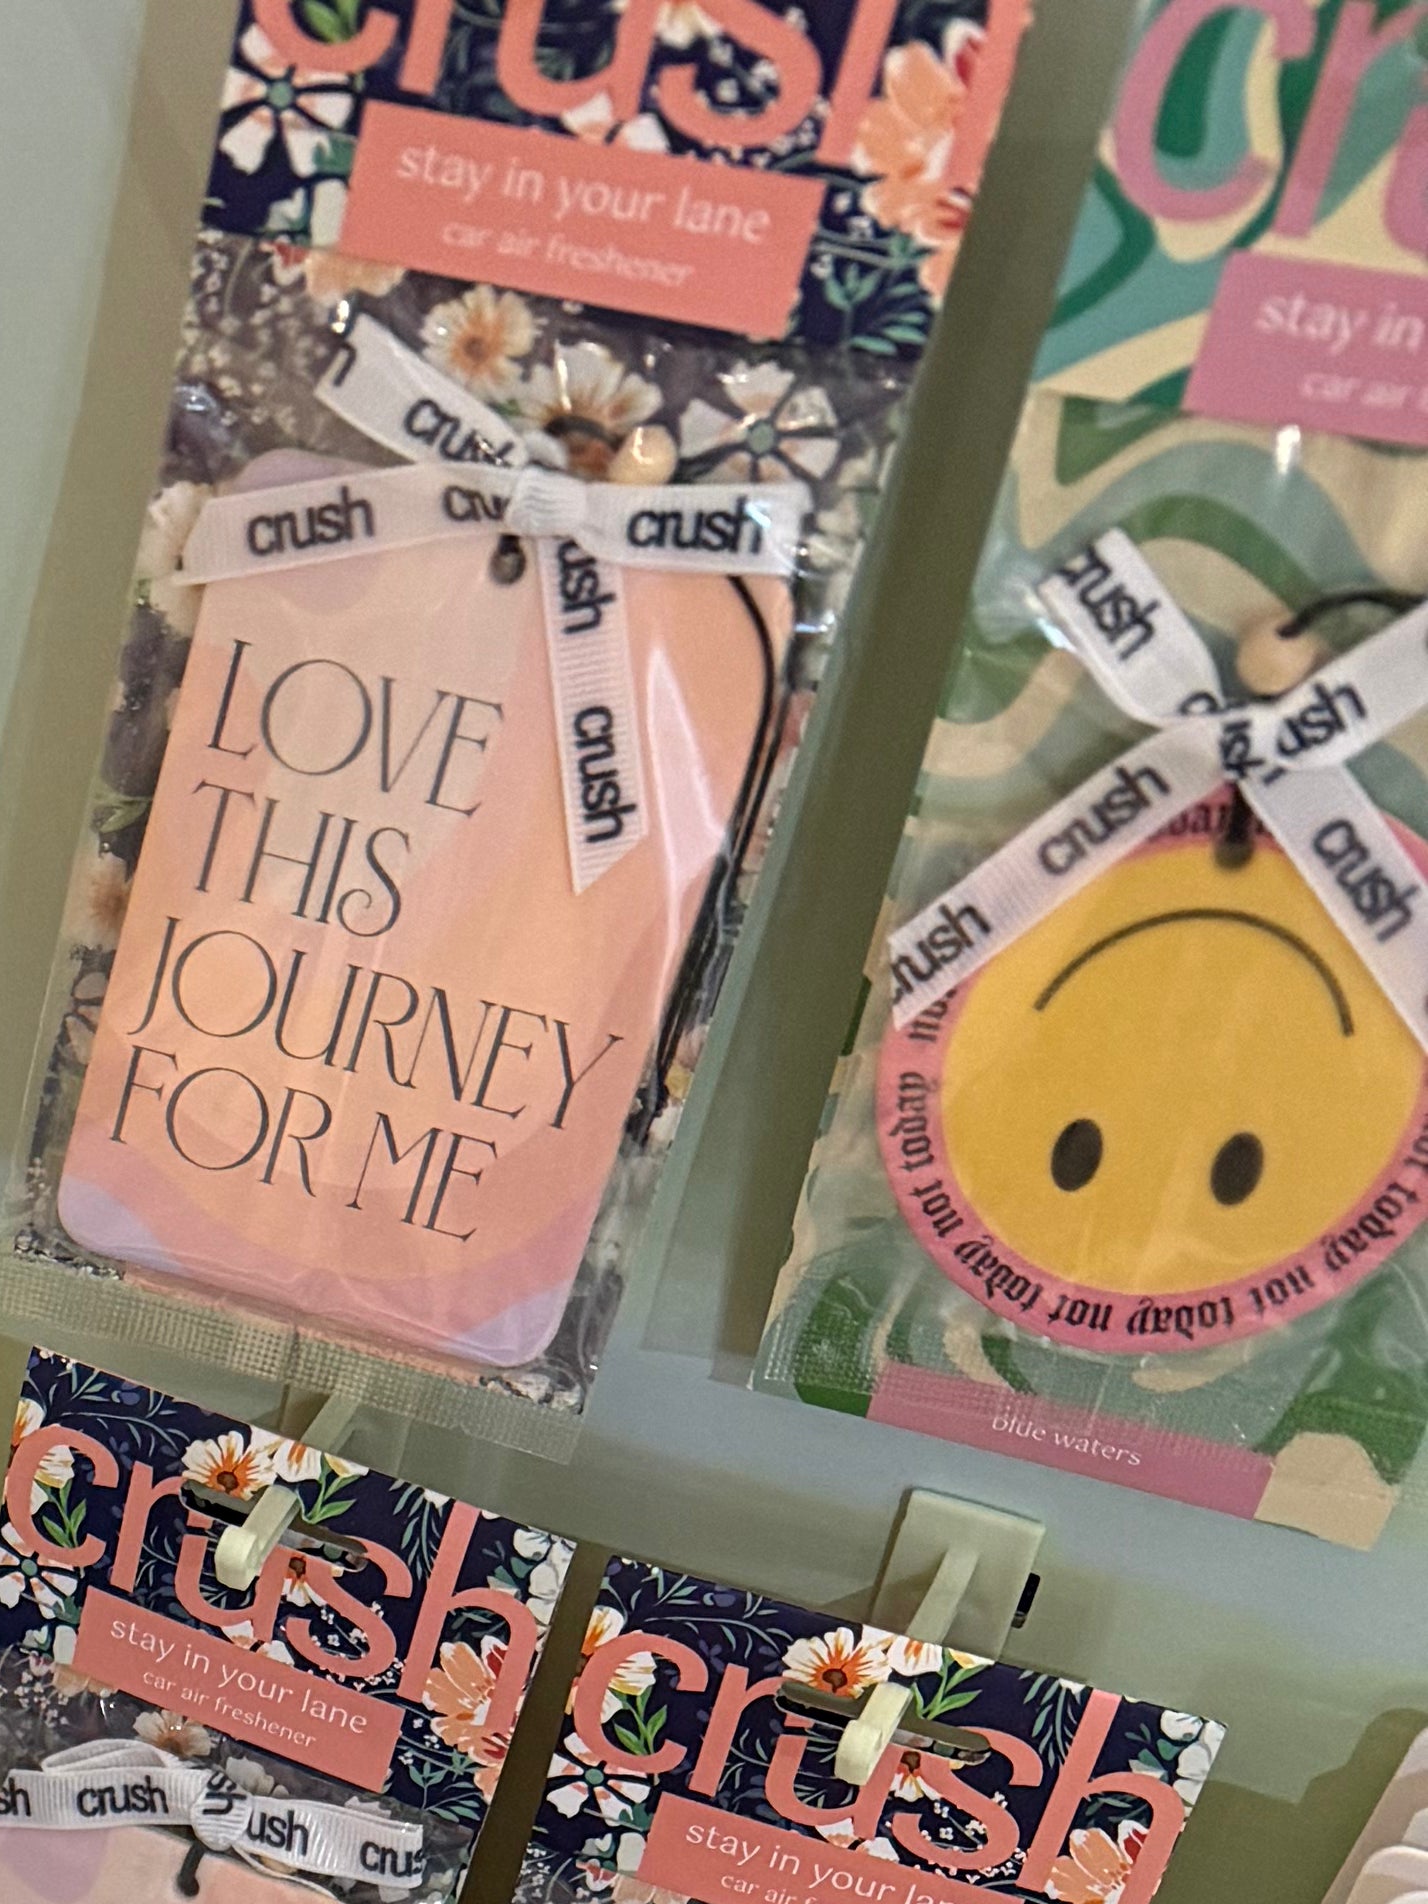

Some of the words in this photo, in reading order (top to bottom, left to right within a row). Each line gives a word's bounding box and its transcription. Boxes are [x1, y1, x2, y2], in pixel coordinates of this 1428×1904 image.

[397, 139, 491, 200] stay
[501, 152, 546, 203] in
[554, 165, 663, 230] your
[675, 171, 773, 245] lane
[443, 218, 488, 248] car
[497, 222, 537, 258] air
[543, 234, 693, 289] freshener
[1258, 293, 1363, 350] stay
[247, 487, 373, 557] crush
[627, 497, 768, 554] crush
[207, 641, 504, 818] LOVE
[575, 705, 637, 843] crush
[193, 779, 411, 937] THIS
[1037, 766, 1172, 875] crush
[1313, 819, 1415, 944] crush
[128, 916, 623, 1129] JOURNEY
[108, 1045, 333, 1196] FOR
[346, 1113, 499, 1242] ME
[897, 1072, 934, 1175] today
[910, 1179, 964, 1239] not
[1323, 1182, 1417, 1273] today
[954, 1234, 1042, 1314] today
[1047, 1293, 1113, 1332] not
[1248, 1266, 1314, 1318] not
[1127, 1296, 1234, 1341] today
[991, 1404, 1046, 1442] blue
[1054, 1431, 1143, 1467] waters
[6, 1425, 537, 1733] crush
[110, 1616, 172, 1662] stay
[184, 1642, 211, 1676] in
[220, 1663, 294, 1706] your
[301, 1687, 368, 1735] lane
[142, 1670, 175, 1693] car
[180, 1682, 210, 1707] air
[214, 1693, 316, 1749] freshener
[76, 1777, 168, 1819] crush
[685, 1820, 760, 1868] stay
[770, 1843, 801, 1878] in
[810, 1860, 897, 1903] your
[720, 1871, 760, 1897] car
